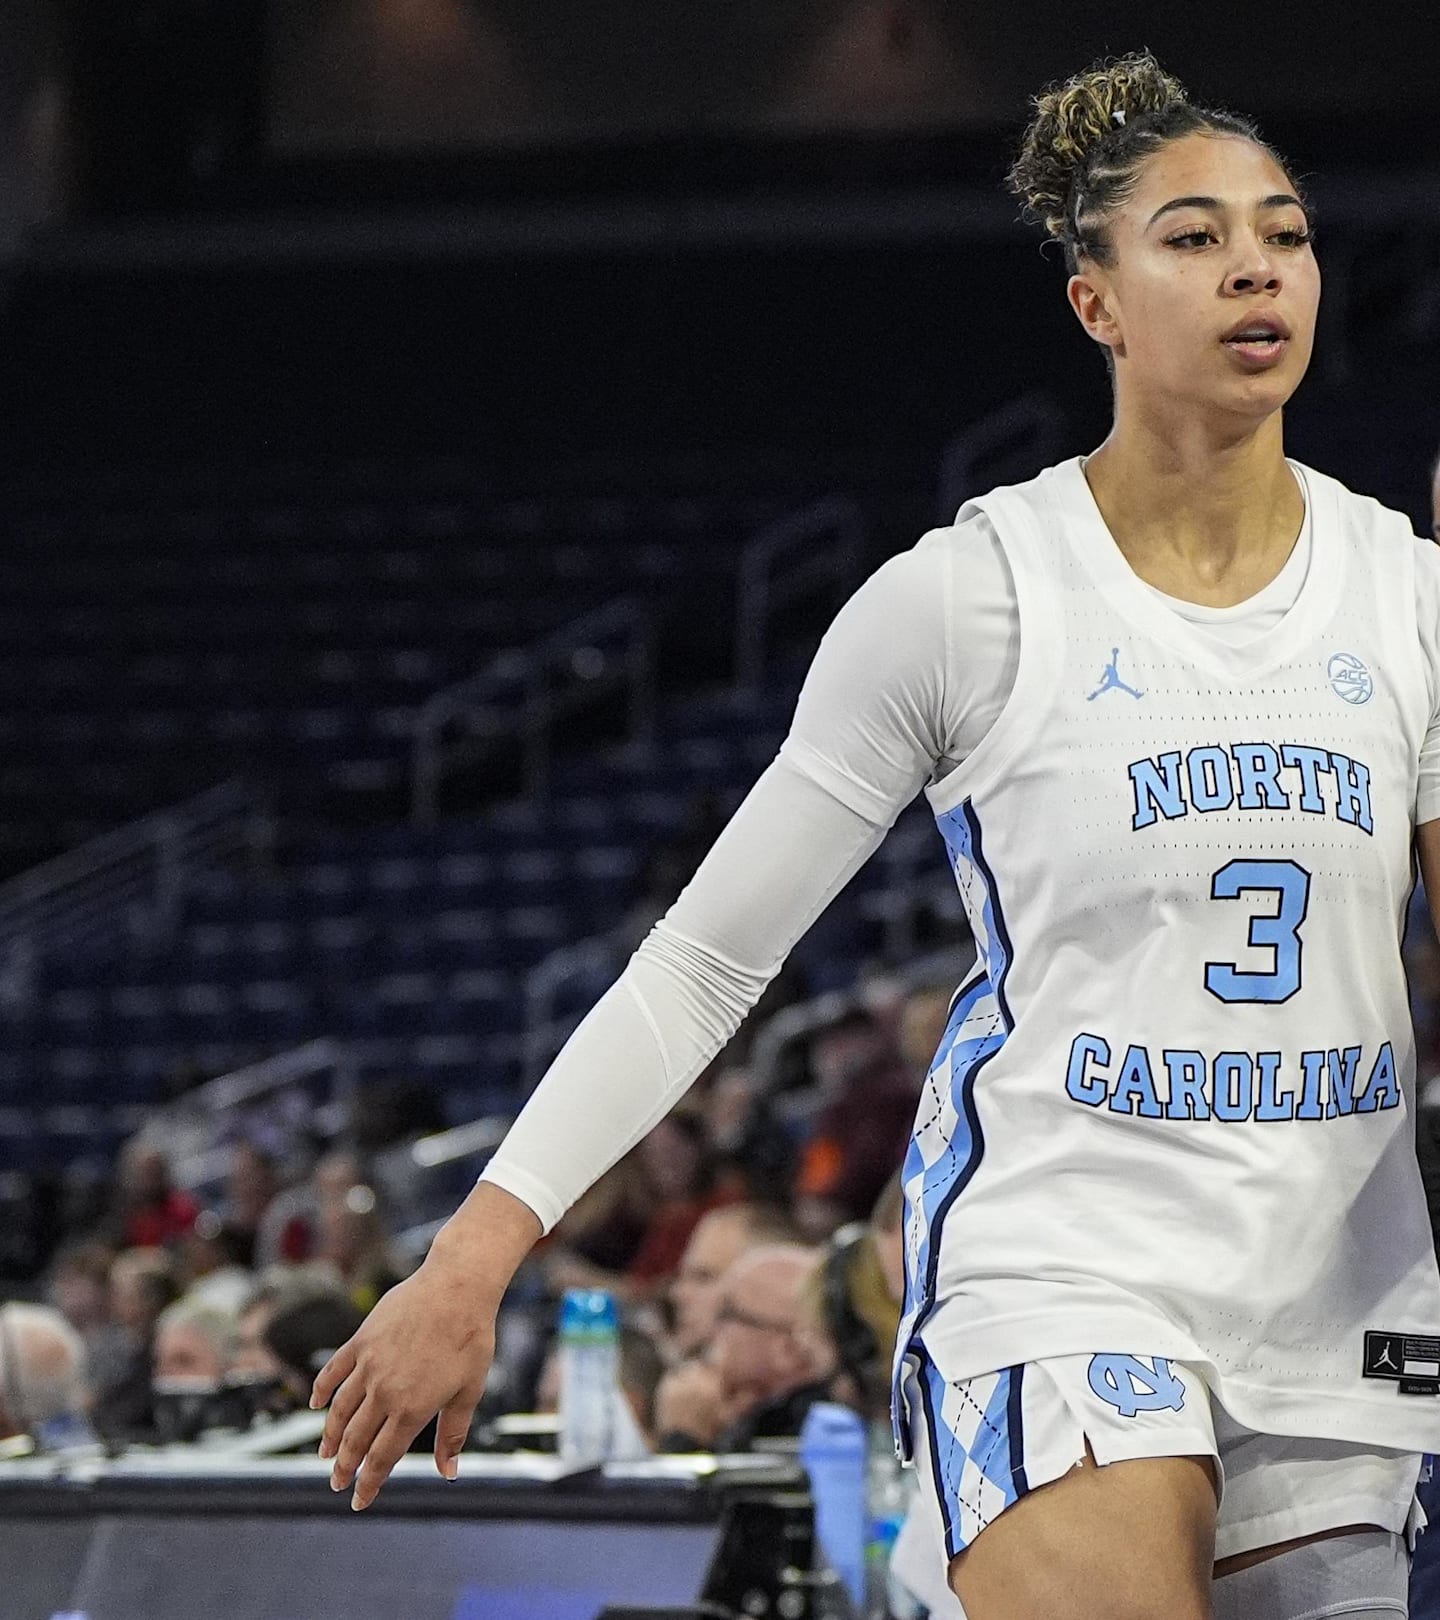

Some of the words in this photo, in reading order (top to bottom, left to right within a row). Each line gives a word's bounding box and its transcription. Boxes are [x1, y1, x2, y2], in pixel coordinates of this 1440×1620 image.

[1335, 669, 1368, 684] ACC
[1129, 743, 1374, 836] NORTH
[1204, 858, 1312, 1004] 3
[1065, 1033, 1401, 1123] CAROLINA
